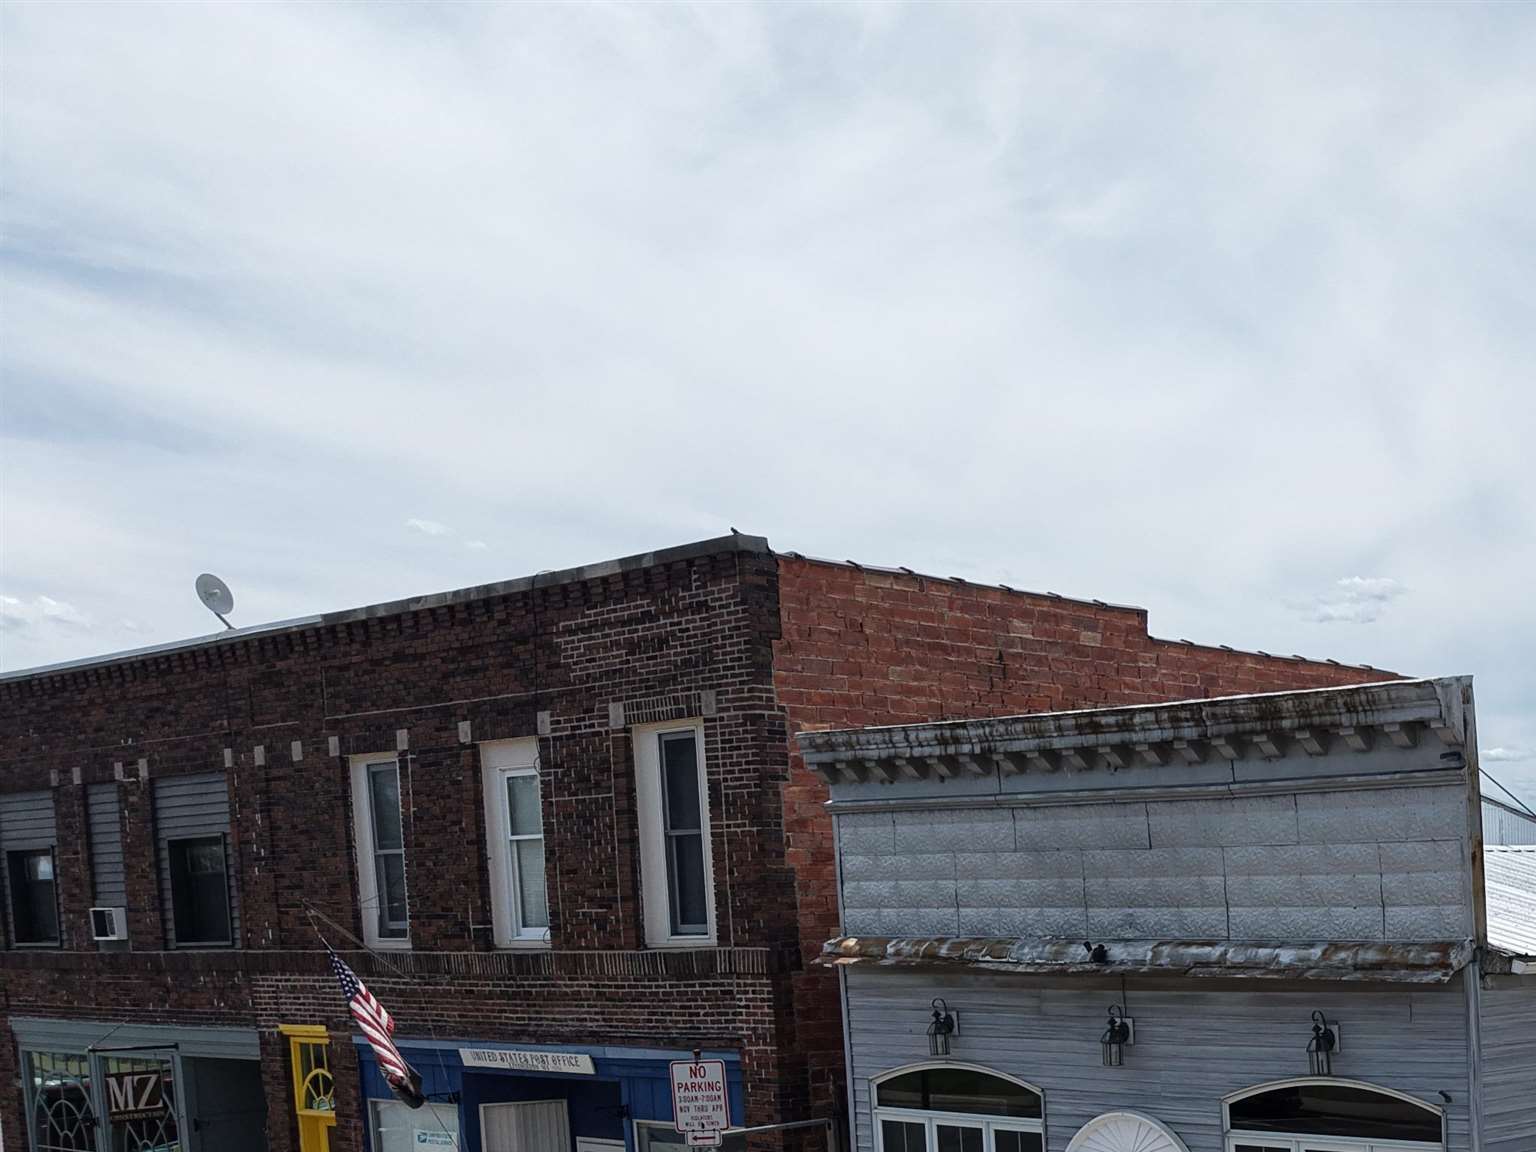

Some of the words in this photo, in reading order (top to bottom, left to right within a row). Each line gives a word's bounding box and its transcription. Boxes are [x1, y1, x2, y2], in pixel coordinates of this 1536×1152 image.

[471, 1050, 498, 1063] UNITED
[499, 1052, 529, 1065] STATES
[530, 1054, 551, 1066] POST
[551, 1056, 581, 1068] OFFICE
[689, 1065, 707, 1079] NO
[105, 1074, 164, 1112] MZ
[677, 1080, 722, 1093] PARKING
